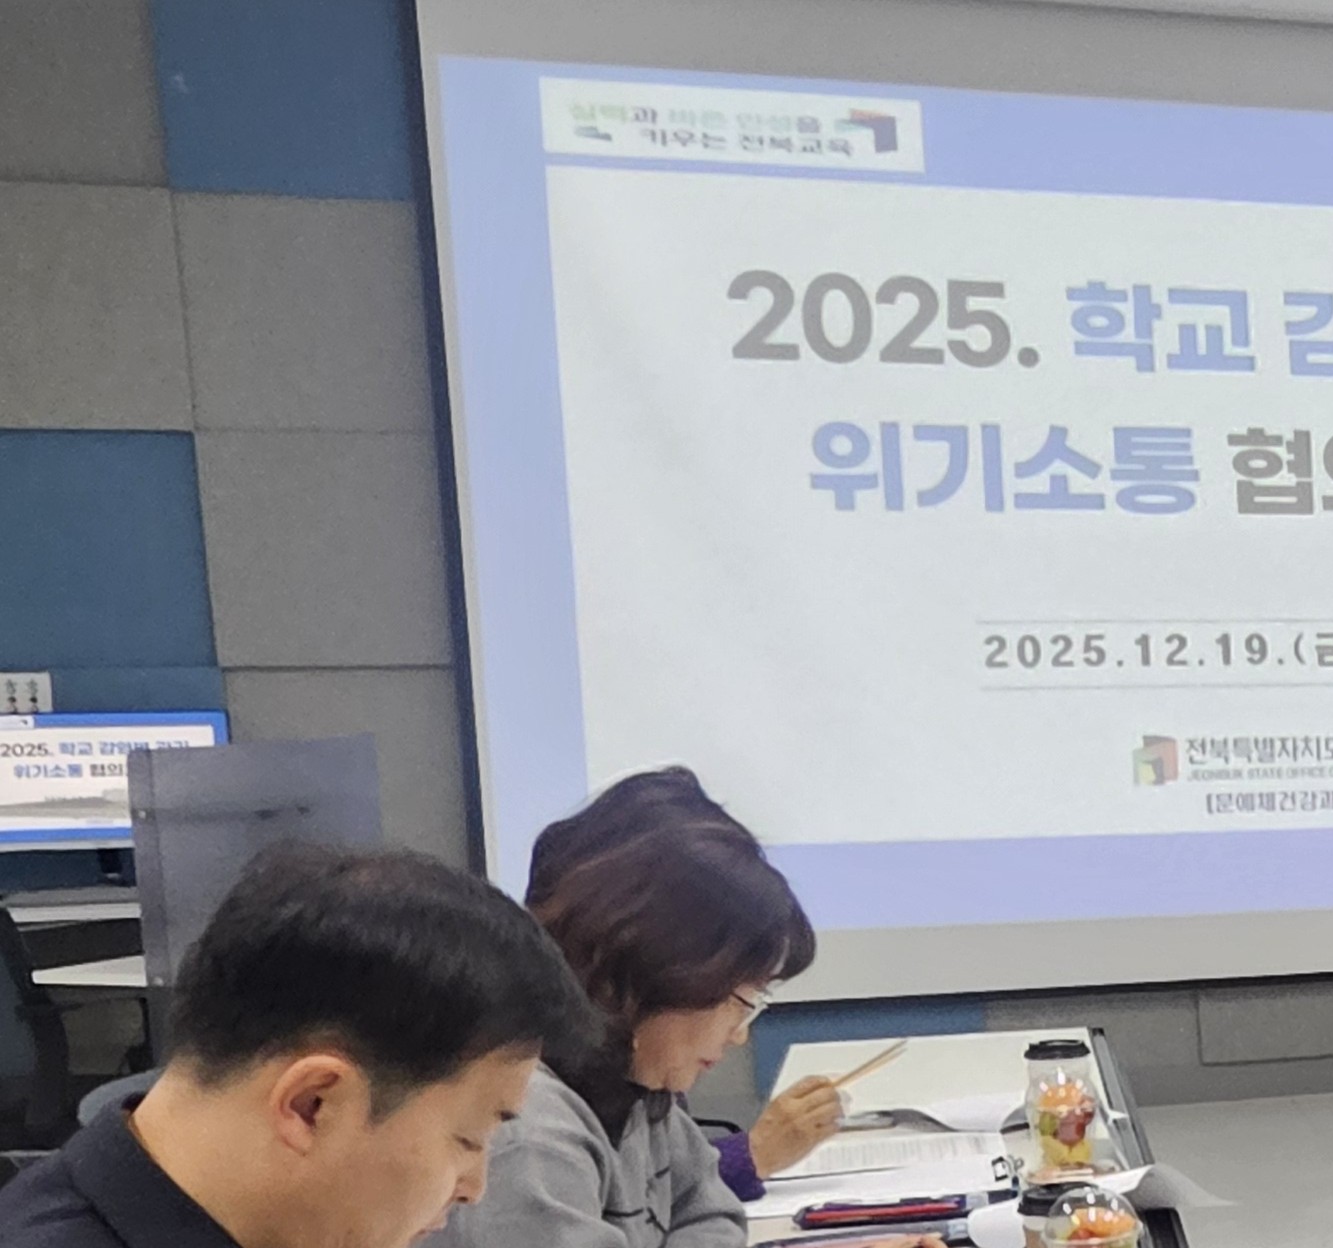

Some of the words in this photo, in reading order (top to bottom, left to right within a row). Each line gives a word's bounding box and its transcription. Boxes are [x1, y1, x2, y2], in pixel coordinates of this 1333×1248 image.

[727, 270, 1040, 368] 2025.
[1066, 280, 1256, 373] 학교
[809, 421, 1200, 515] 위기소통
[59, 742, 93, 756] 학교
[14, 763, 82, 778] 위기소통
[1188, 768, 1242, 781] JEONBUK
[1248, 767, 1282, 780] STATE
[1286, 766, 1325, 779] OFFICE
